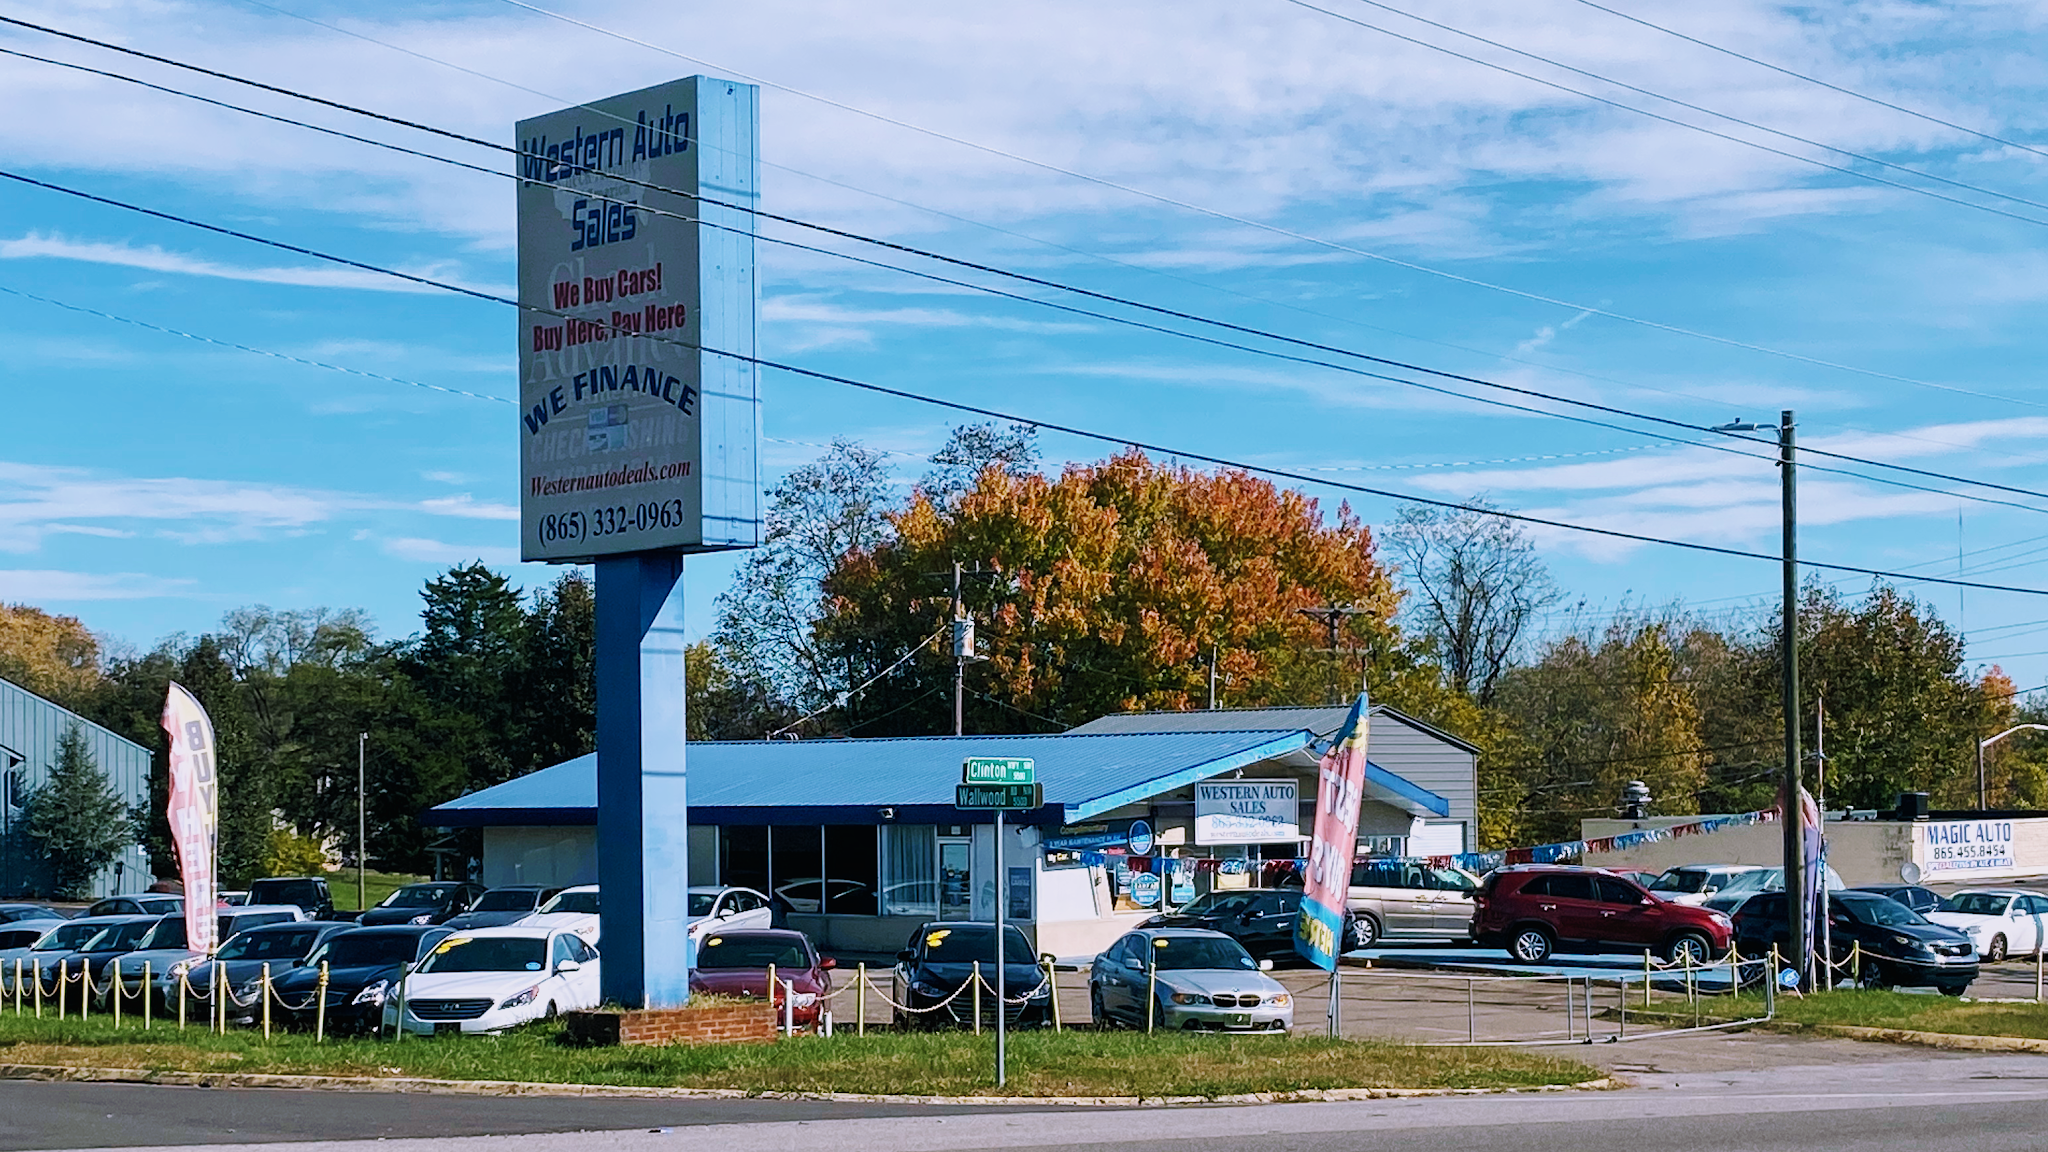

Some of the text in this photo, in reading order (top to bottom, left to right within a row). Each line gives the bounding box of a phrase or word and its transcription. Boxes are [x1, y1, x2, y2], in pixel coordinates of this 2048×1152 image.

[523, 104, 689, 187] Western Auto
[571, 200, 637, 252] Sales
[553, 261, 662, 310] We Buy Cars!
[533, 303, 686, 352] Buy Here, Pay Here
[524, 364, 697, 436] WE FINANCE
[531, 460, 691, 498] Westernautodeals.com
[538, 499, 684, 548] (865) 332-0963
[970, 761, 1007, 779] Clinton
[959, 787, 1007, 806] Wallwood
[1200, 785, 1295, 800] WESTERN AUTO
[1230, 801, 1266, 814] SALES
[1927, 822, 2011, 845] MAGIC AUTO
